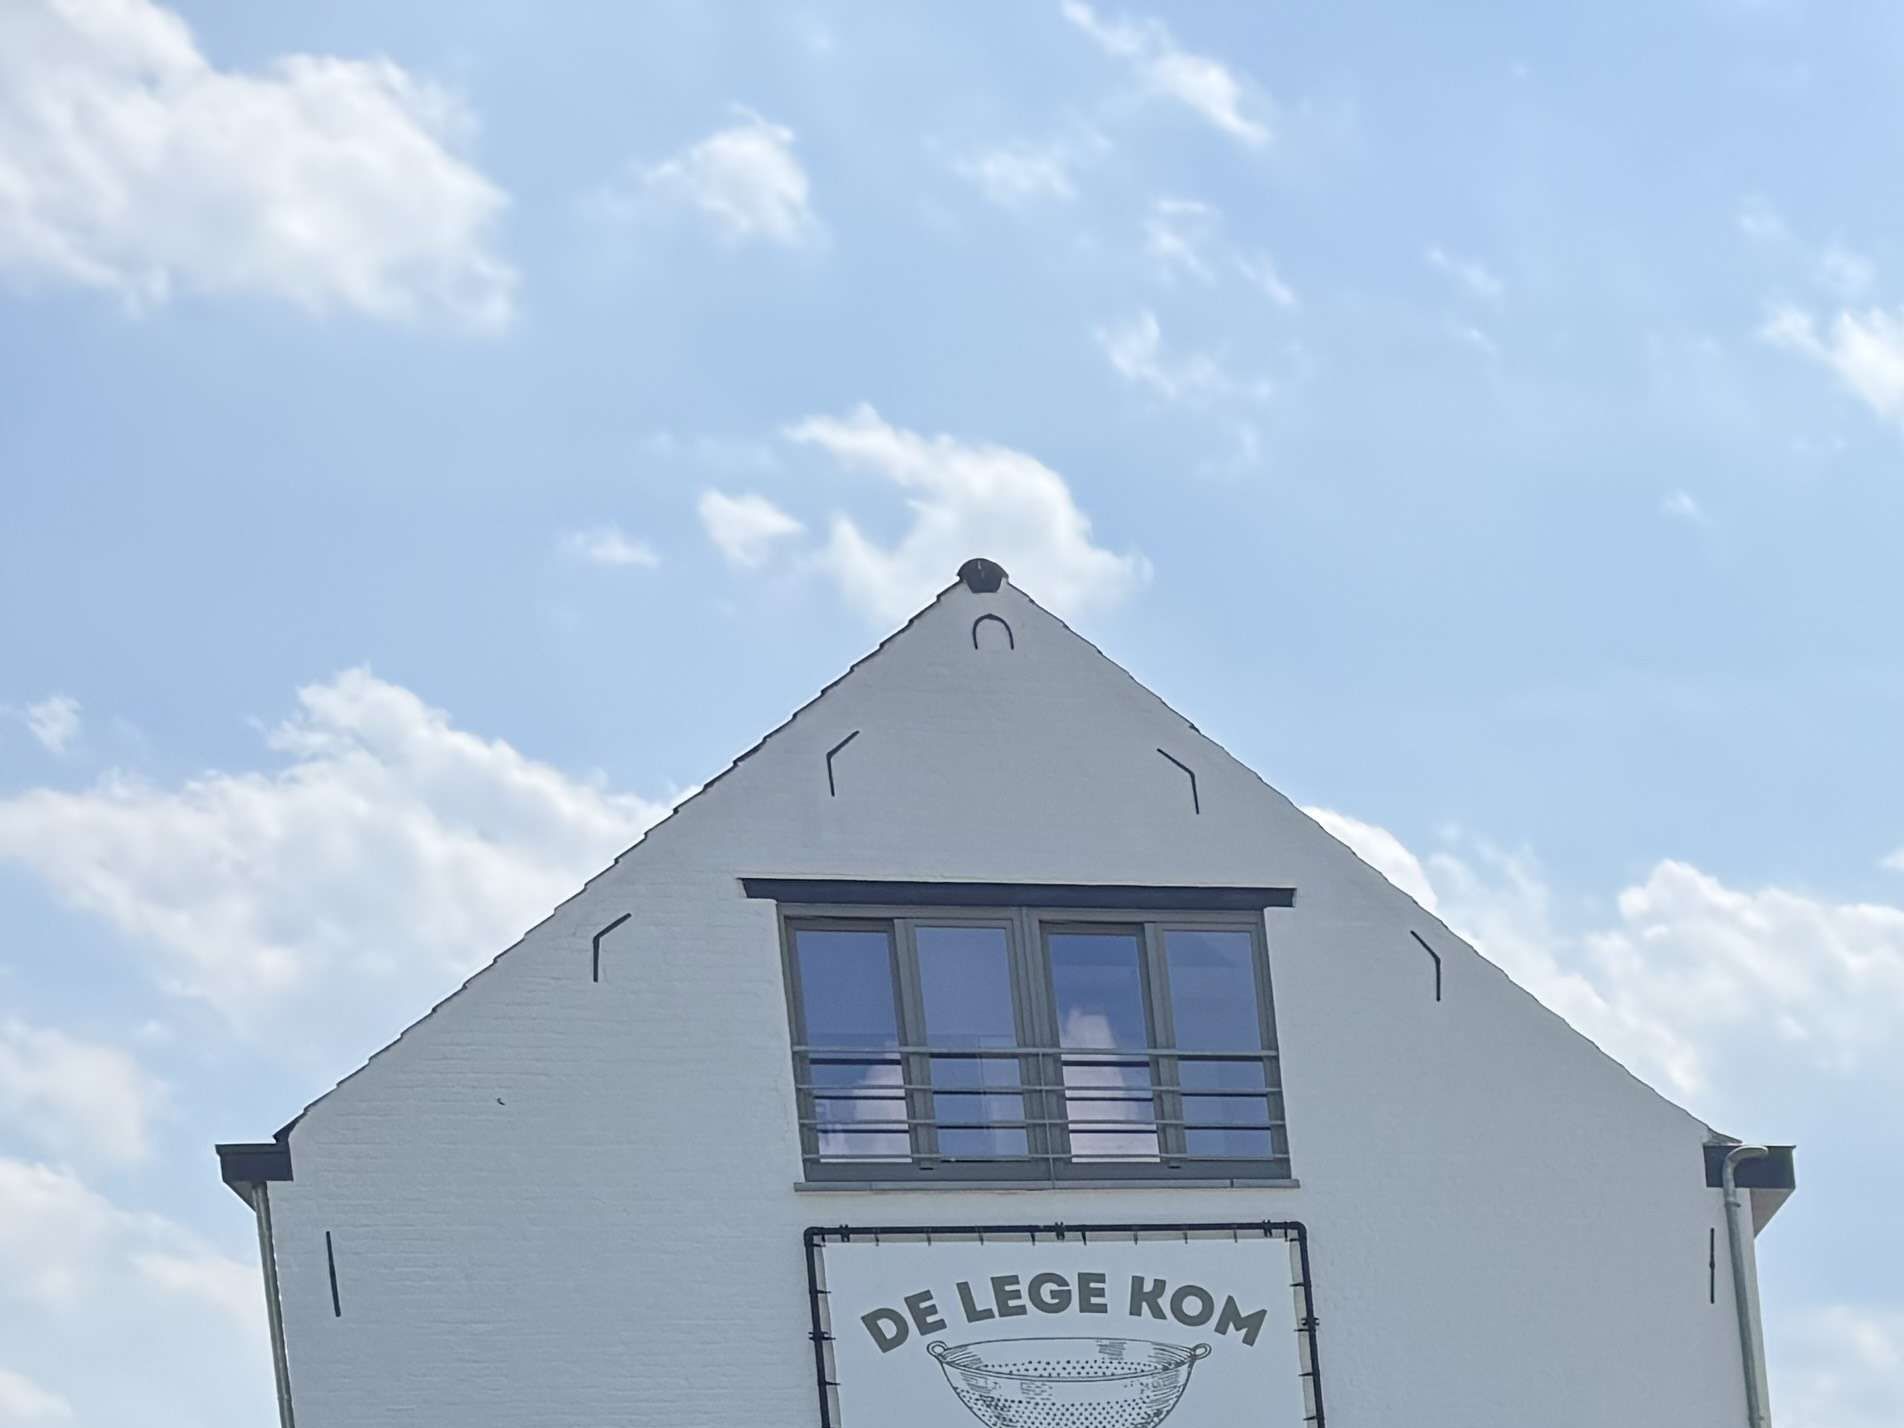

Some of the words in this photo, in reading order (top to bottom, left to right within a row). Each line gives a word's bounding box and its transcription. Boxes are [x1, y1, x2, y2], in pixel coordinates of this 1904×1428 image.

[860, 1289, 947, 1353] DE
[956, 1272, 1108, 1324] LEGE
[1129, 1275, 1268, 1346] KOM
